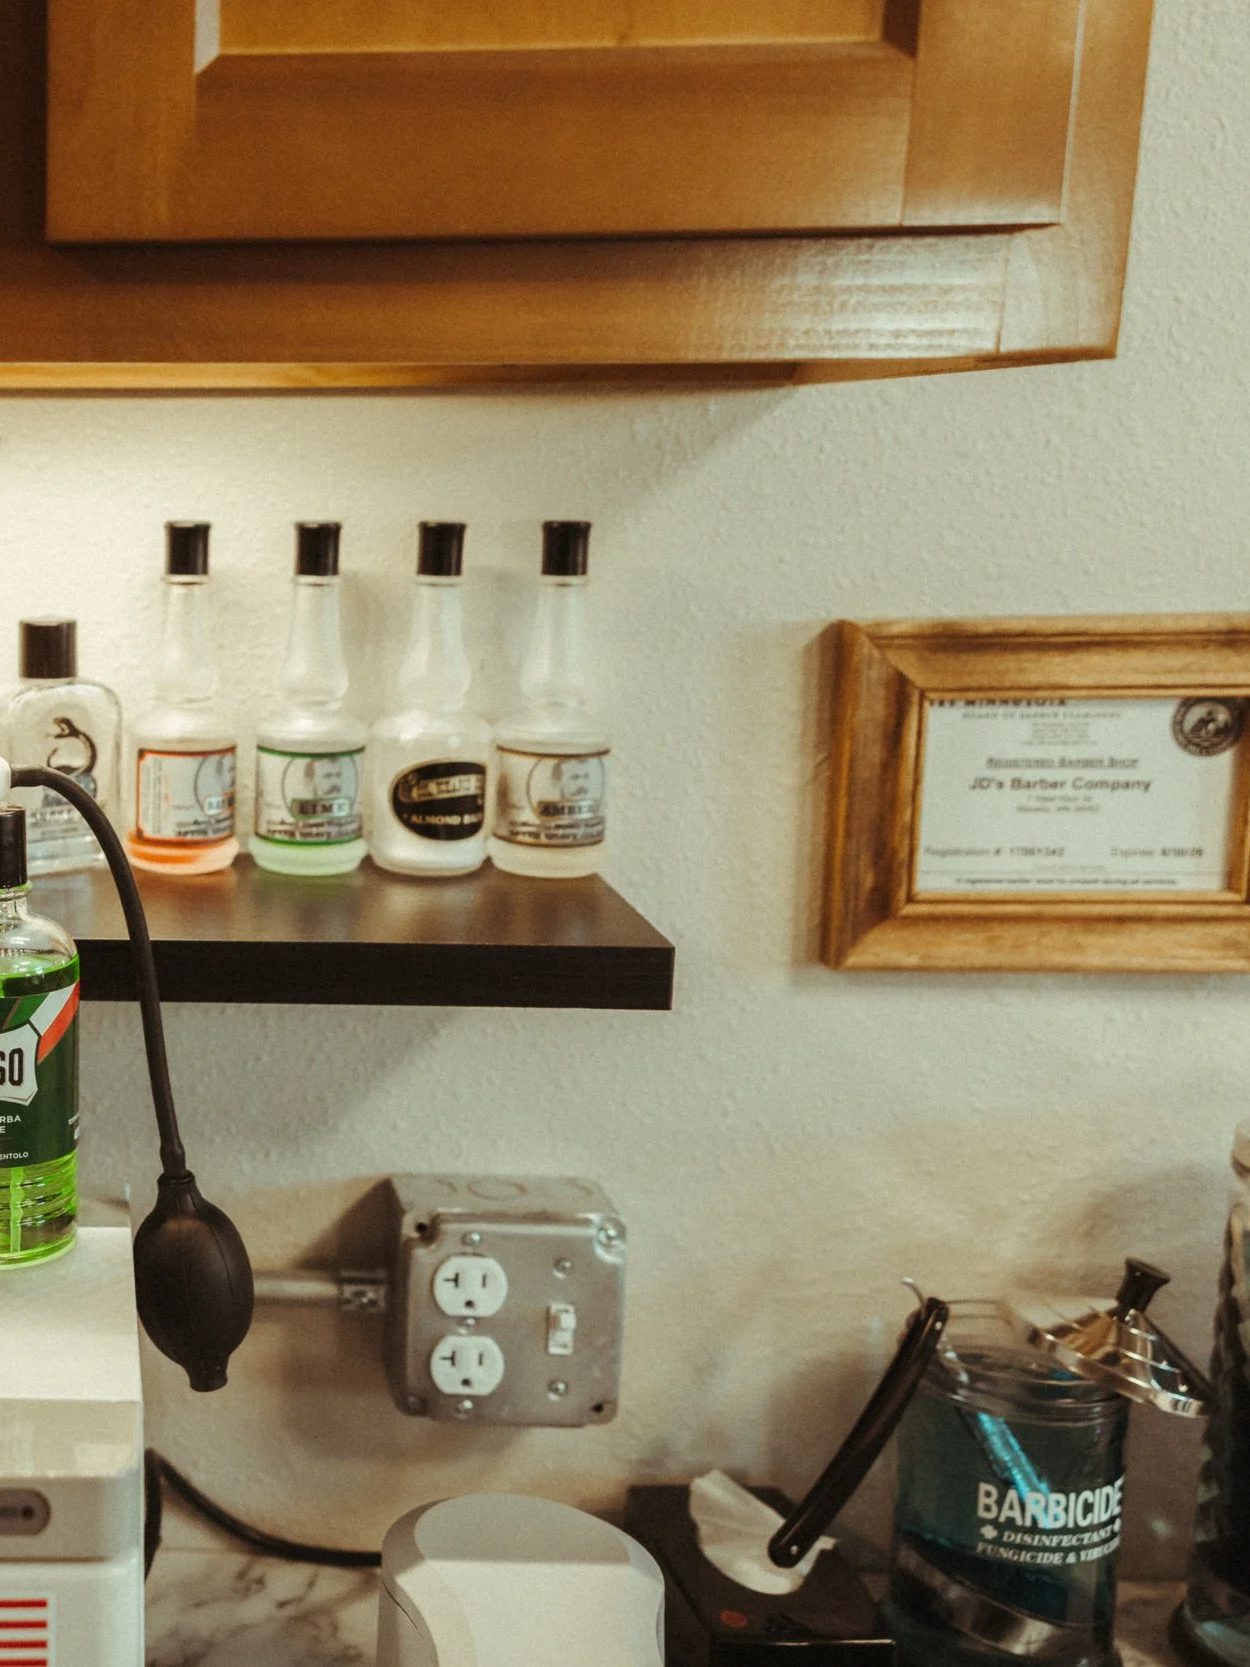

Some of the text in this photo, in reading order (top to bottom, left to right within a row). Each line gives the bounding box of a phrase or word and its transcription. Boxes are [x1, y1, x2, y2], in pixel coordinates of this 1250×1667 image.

[1010, 776, 1067, 790] Barber
[1071, 776, 1152, 792] Company
[977, 1475, 1125, 1530] BARBICIDE
[1002, 1524, 1114, 1547] DISINFECTANT
[975, 1541, 1065, 1565] FUNGICIDE
[1065, 1551, 1077, 1564] &
